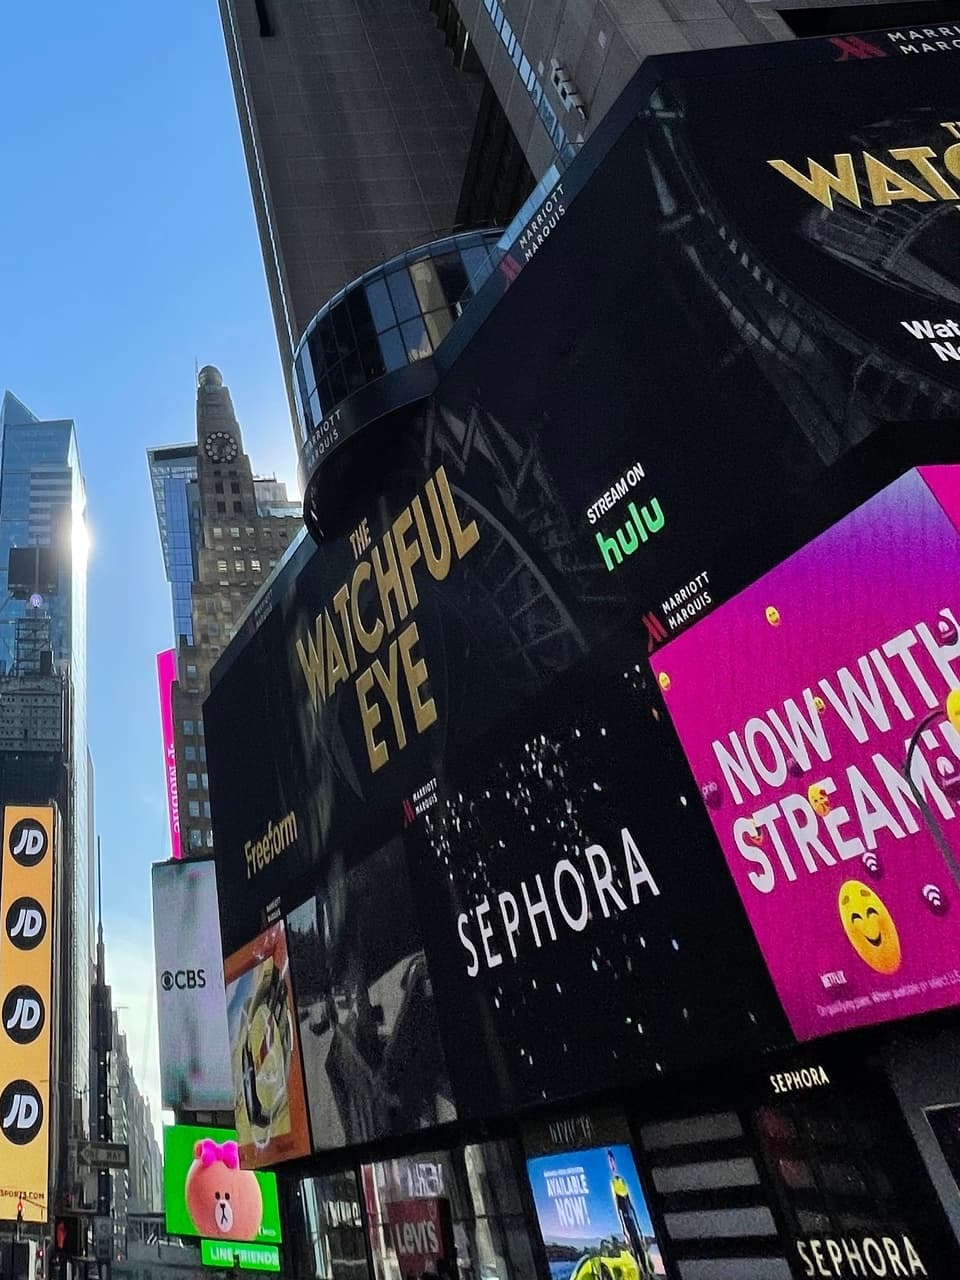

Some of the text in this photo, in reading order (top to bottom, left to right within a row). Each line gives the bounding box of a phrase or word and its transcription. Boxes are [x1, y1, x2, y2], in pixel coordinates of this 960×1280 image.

[519, 183, 565, 249] MARRIOTT
[524, 204, 566, 262] MARQUIS
[586, 462, 646, 525] STREAM ON
[350, 516, 372, 560] THE
[595, 496, 665, 572] hulu
[295, 464, 481, 713] WATCHFUL
[661, 571, 711, 615] MARRIOTT
[667, 591, 712, 630] MARQUIS
[355, 621, 439, 774] EYE
[712, 688, 832, 806] NOW
[13, 829, 44, 855] JD
[244, 810, 298, 879] Freeform
[10, 908, 43, 937] JD
[457, 826, 661, 978] SEPHORA
[175, 969, 206, 990] CBS
[7, 998, 41, 1029] JD
[770, 1065, 831, 1094] SEPHORA
[3, 1094, 39, 1129] JD
[546, 1173, 589, 1197] AVAILABLE
[554, 1196, 591, 1227] NOW!
[796, 1233, 929, 1278] SEPHORA
